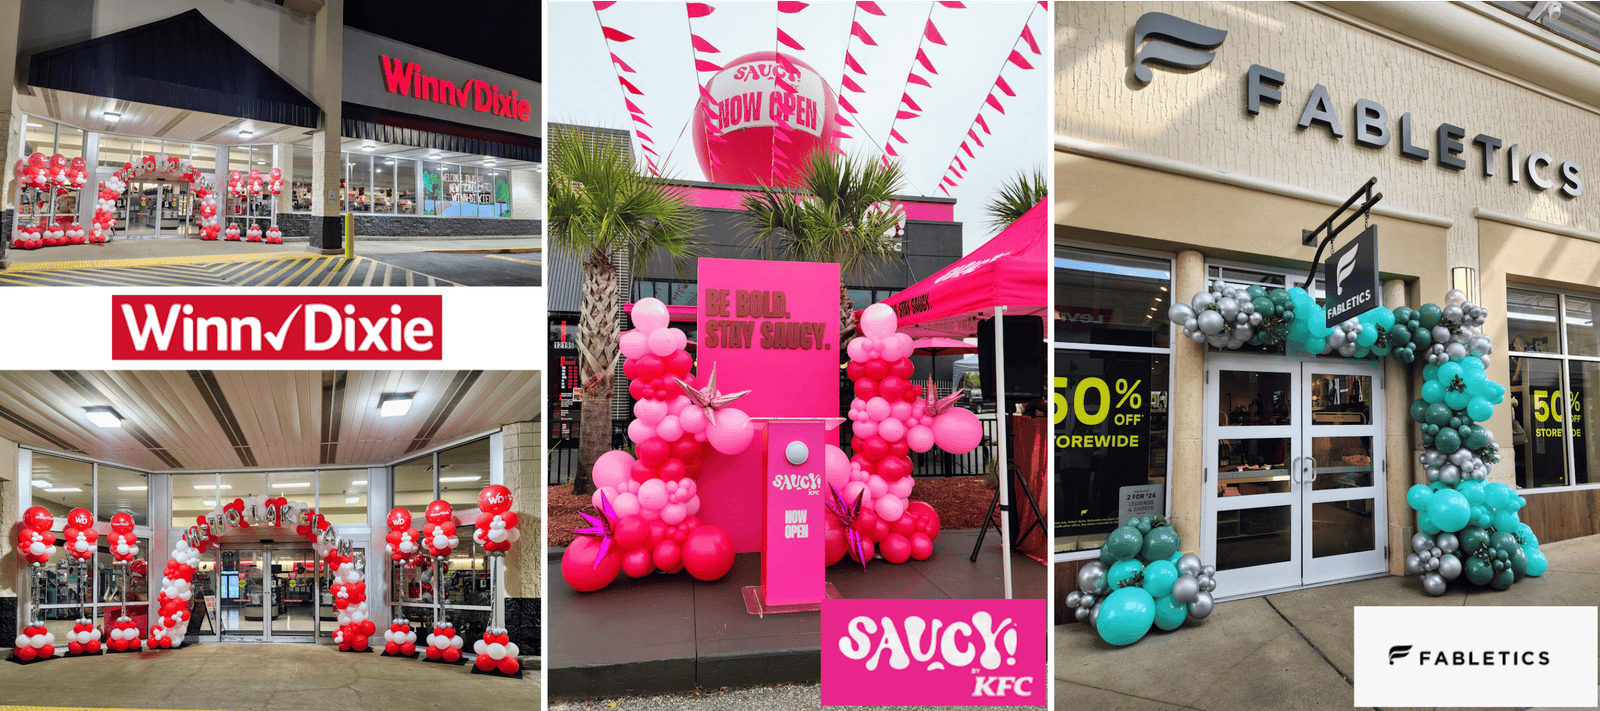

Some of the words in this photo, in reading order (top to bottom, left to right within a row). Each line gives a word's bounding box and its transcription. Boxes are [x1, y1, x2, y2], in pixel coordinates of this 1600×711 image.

[733, 63, 801, 82] SAUC!
[718, 91, 763, 130] NOW
[769, 91, 817, 131] OPEN
[1247, 63, 1584, 199] FABLETICS
[705, 288, 730, 317] BE
[736, 289, 791, 319] BOLD.
[1327, 289, 1371, 320] FABLETICS
[705, 319, 756, 349] STAY
[760, 321, 831, 351] SAUCY.
[1054, 435, 1139, 448] OREWIDE
[1535, 428, 1581, 438] STOREDE
[772, 472, 821, 491] SAUCY!
[785, 509, 807, 524] NOW
[785, 524, 809, 539] OPEN
